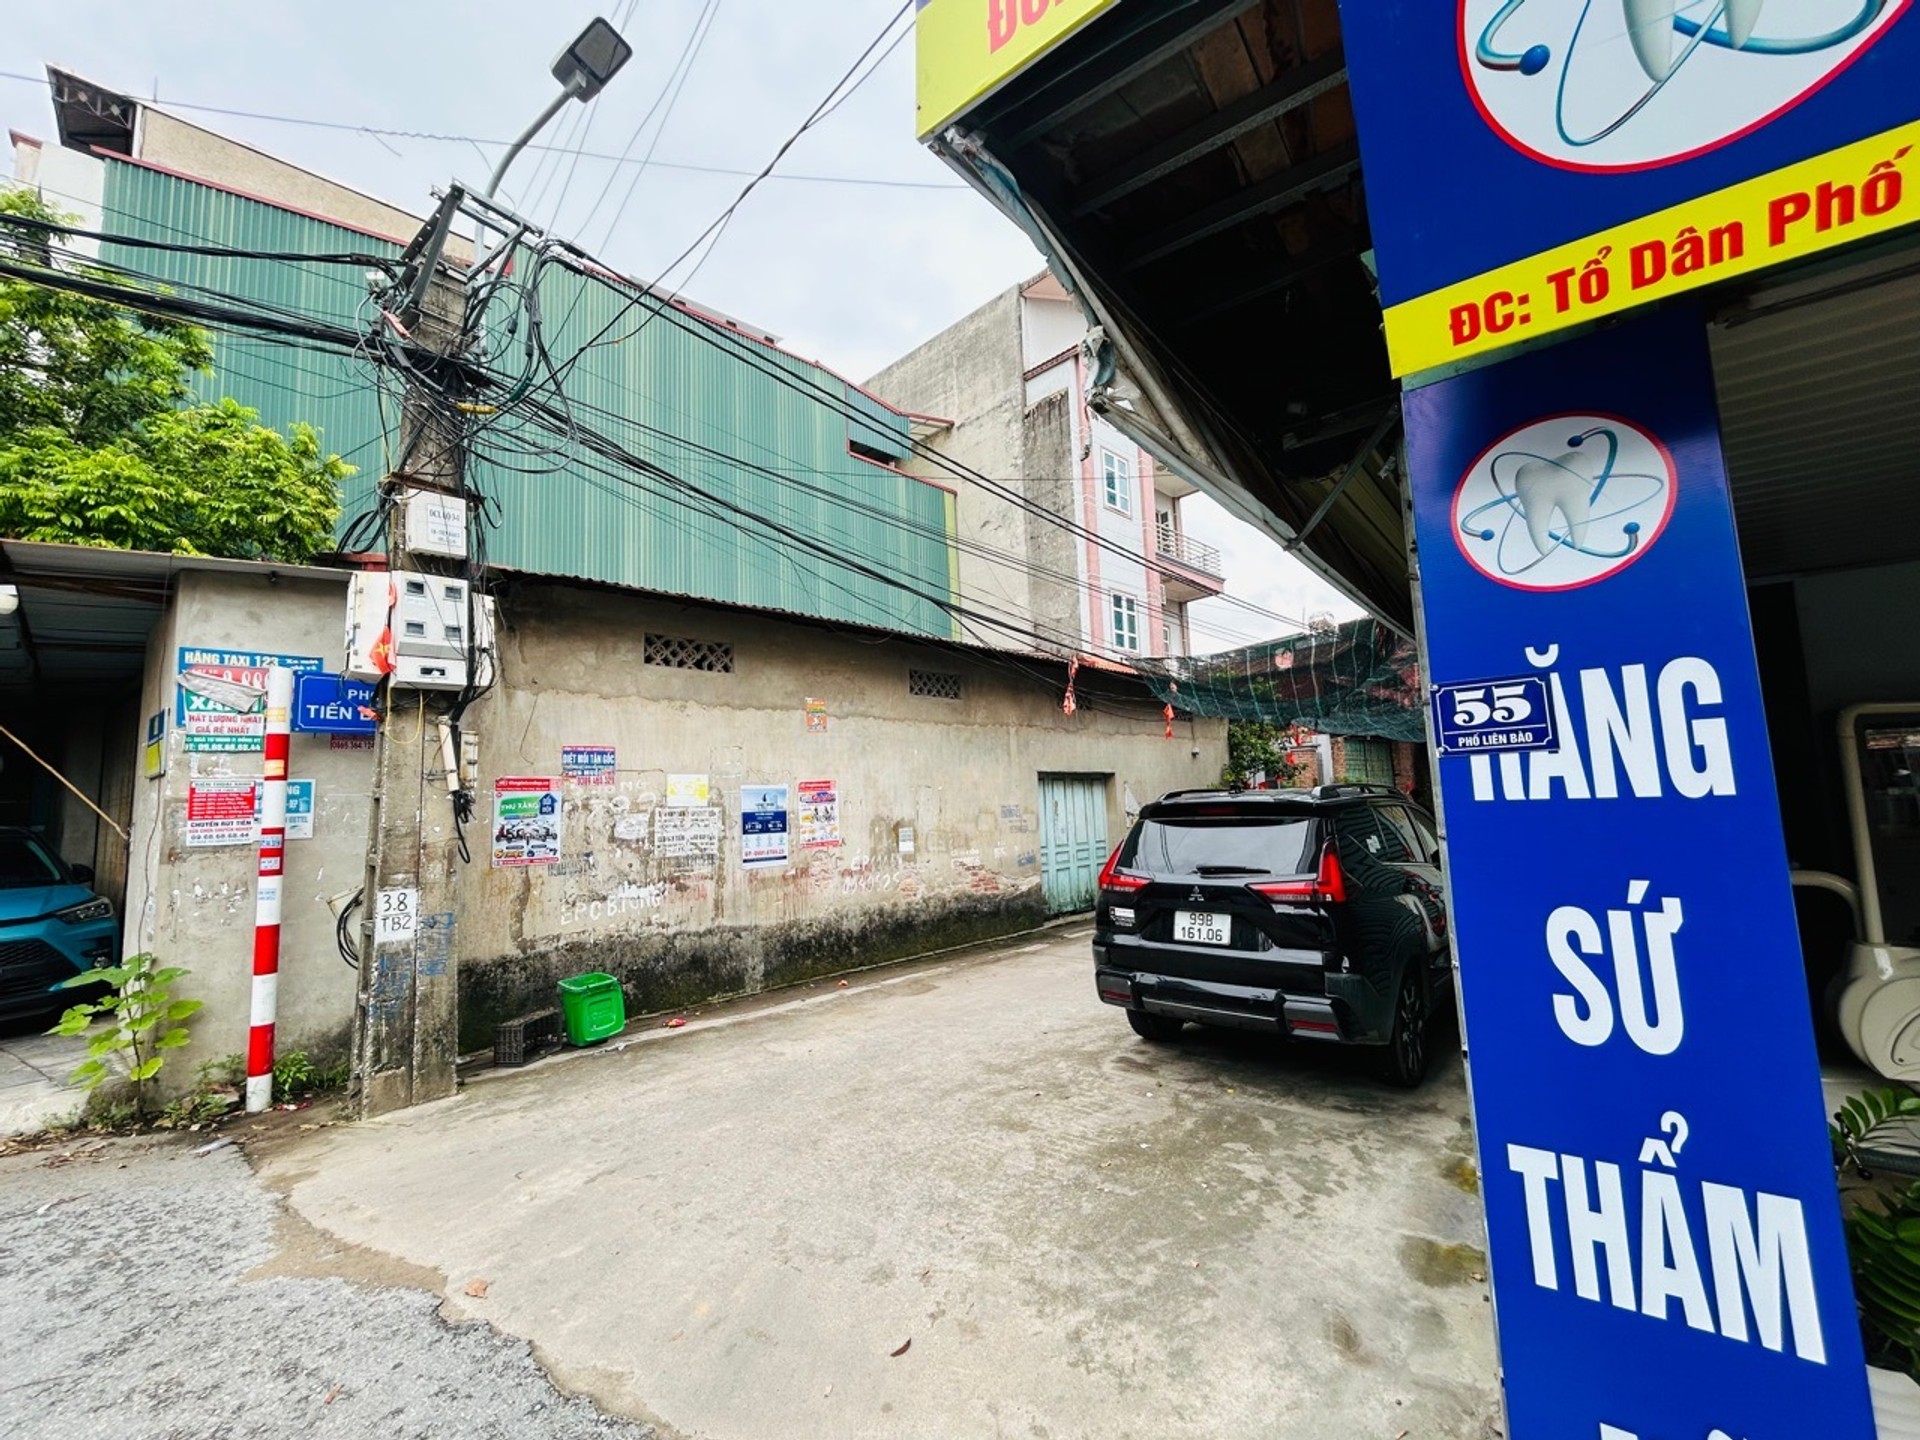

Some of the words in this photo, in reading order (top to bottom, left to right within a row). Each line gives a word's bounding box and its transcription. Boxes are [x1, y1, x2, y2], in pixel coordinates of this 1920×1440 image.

[1449, 291, 1531, 347] ĐC:
[1547, 246, 1610, 314] Tổ
[1629, 222, 1744, 290] Dân
[1769, 144, 1914, 247] Phố
[223, 654, 250, 666] TAXI
[254, 656, 279, 667] 123
[348, 689, 374, 700] PH
[306, 701, 353, 720] TIẾN
[1453, 684, 1532, 726] 55
[1458, 732, 1480, 747] PHỐ
[1482, 732, 1507, 745] LIÊN
[382, 892, 408, 912] 3.8
[381, 915, 412, 932] TB2
[1189, 913, 1213, 926] 99B
[1181, 926, 1223, 942] 161.06
[1545, 880, 1684, 1055] SỨ
[1507, 1111, 1827, 1365] THẨM
